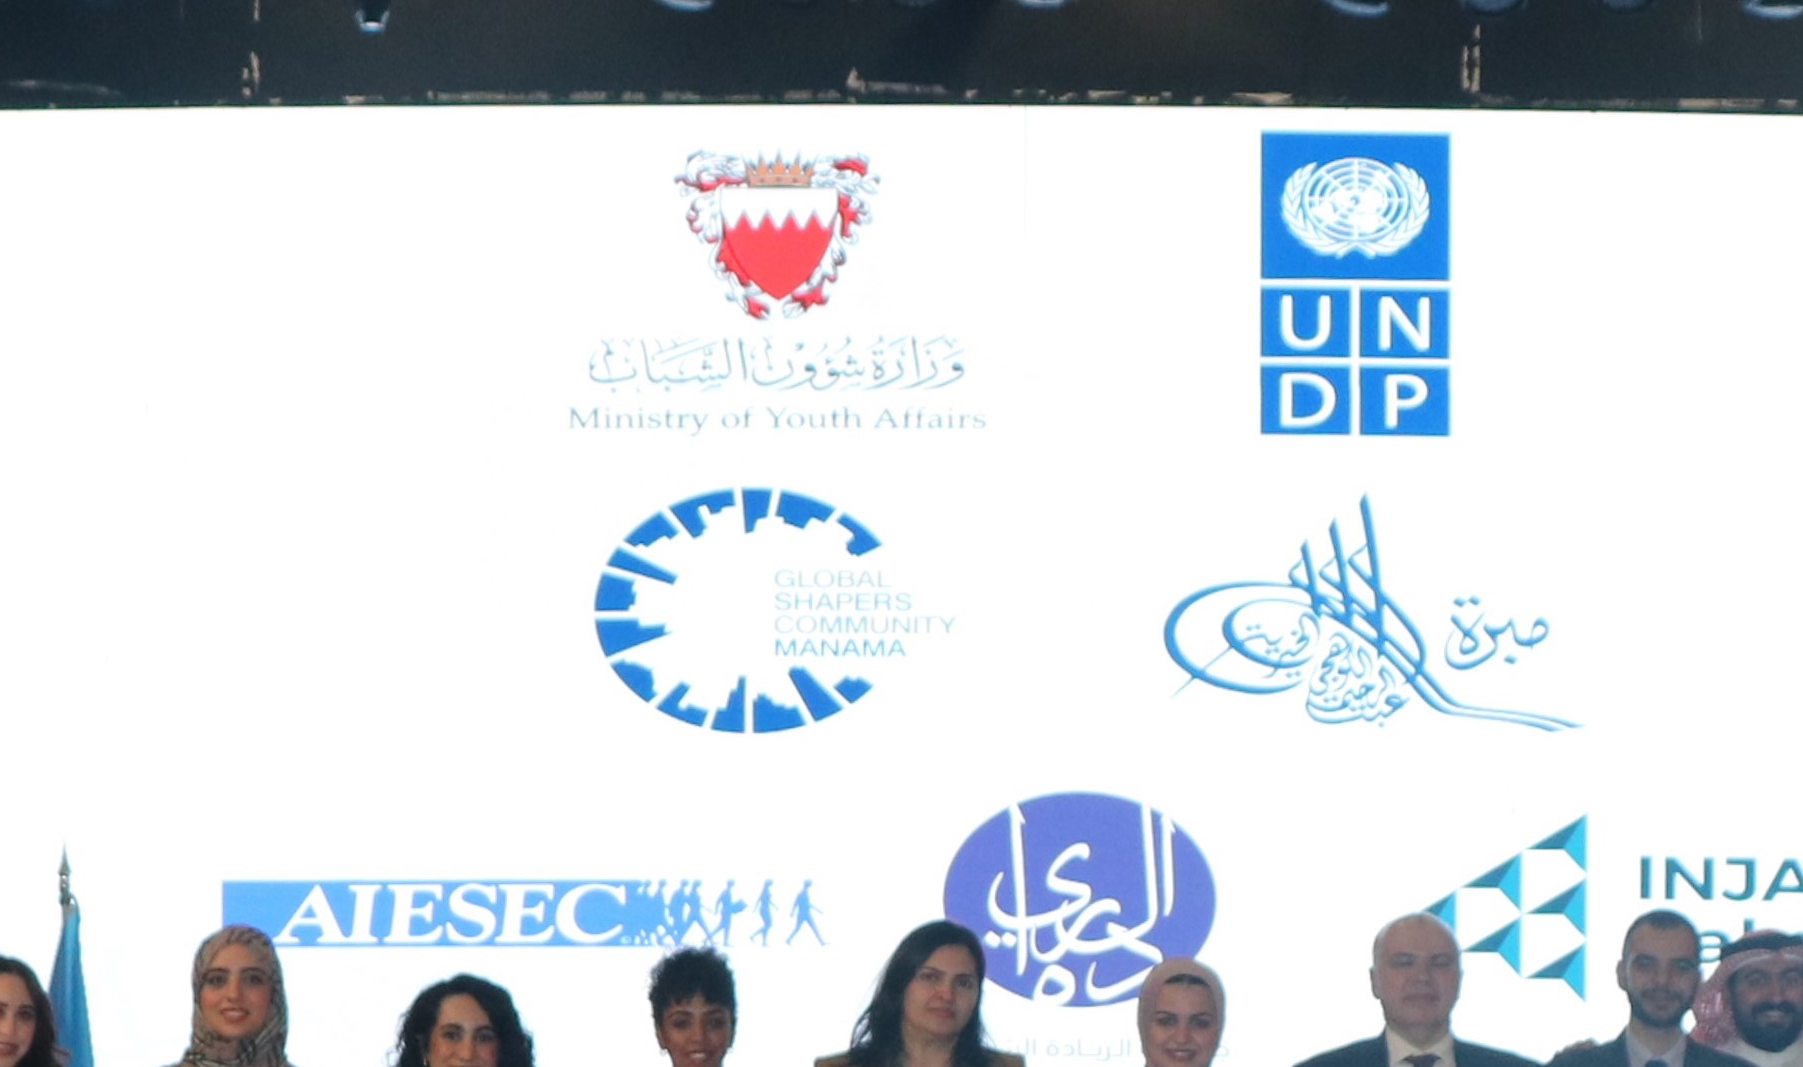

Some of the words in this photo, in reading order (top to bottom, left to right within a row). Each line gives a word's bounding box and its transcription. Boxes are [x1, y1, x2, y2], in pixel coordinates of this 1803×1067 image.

[567, 405, 708, 437] Ministry
[720, 405, 754, 430] of
[764, 405, 862, 430] Youth
[873, 405, 988, 430] Affairs
[773, 568, 893, 589] GLOBAL
[773, 591, 914, 612] SHAPERS
[773, 614, 957, 635] COMMUNITY
[774, 638, 908, 658] MANAMA
[272, 882, 627, 945] AIESEC
